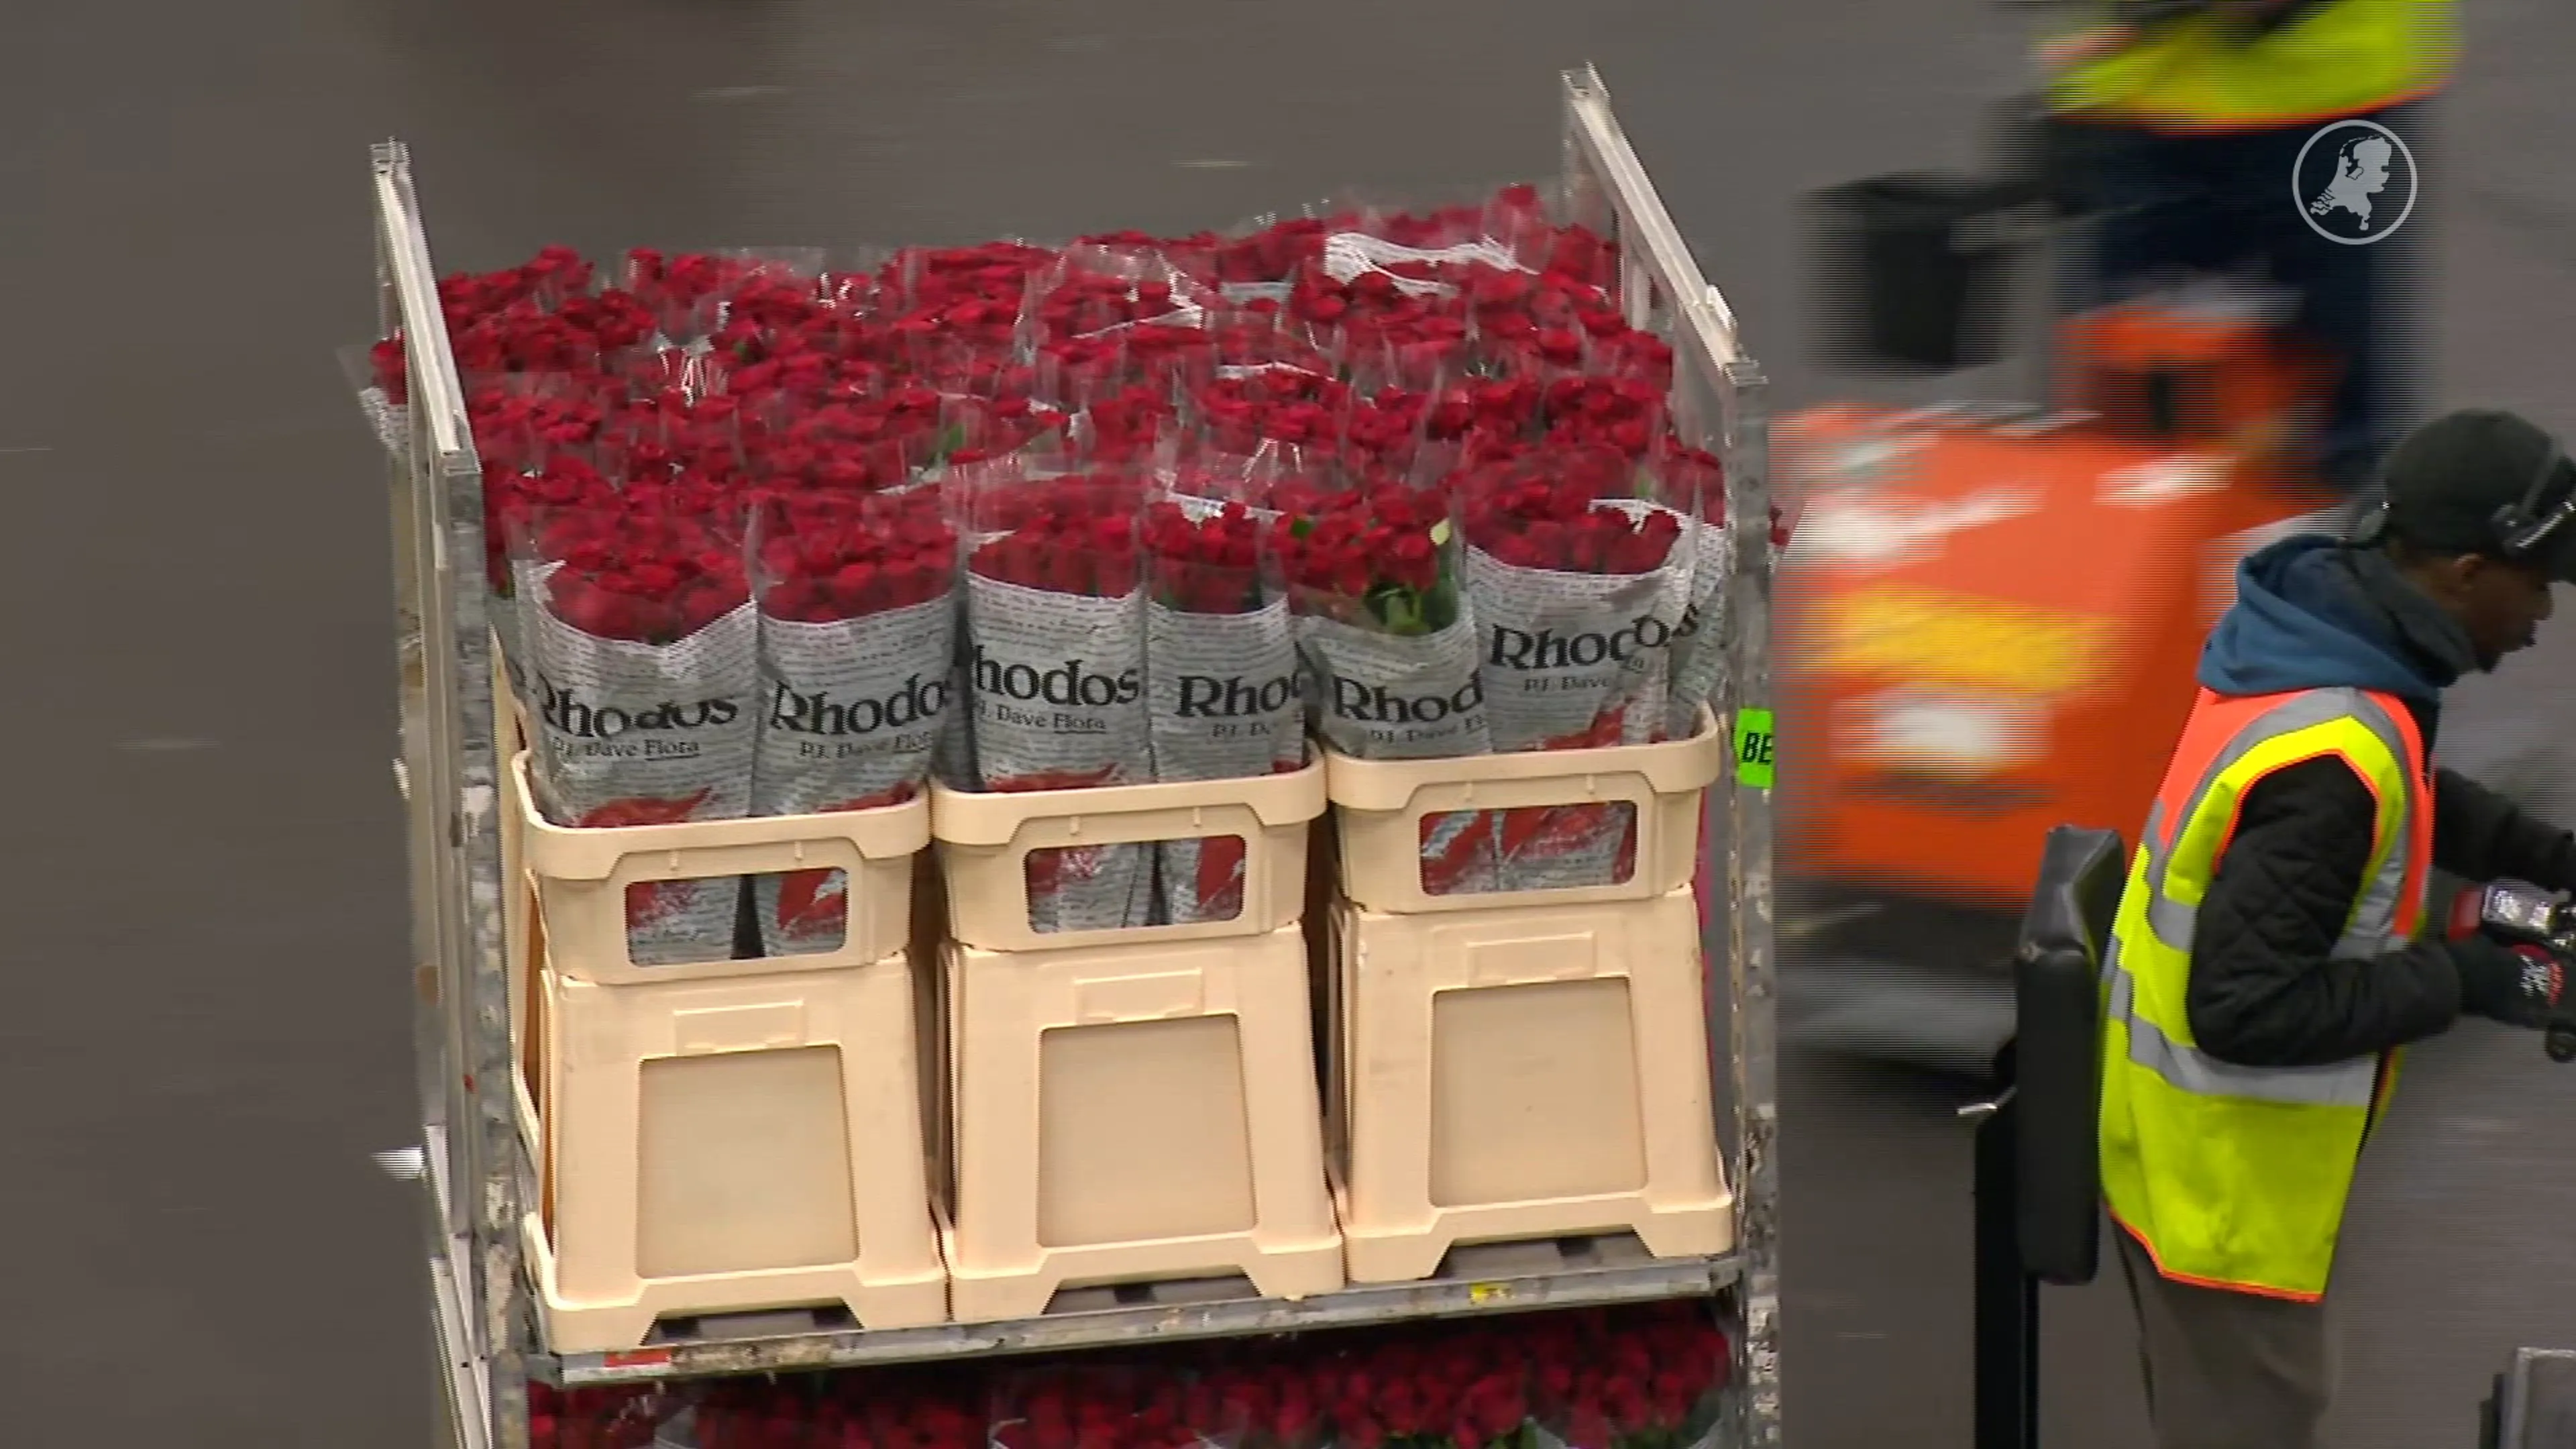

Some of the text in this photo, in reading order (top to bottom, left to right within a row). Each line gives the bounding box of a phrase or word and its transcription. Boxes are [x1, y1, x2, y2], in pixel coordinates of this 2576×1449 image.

[975, 644, 1139, 706] hodos
[1173, 670, 1301, 716] Rho
[1333, 667, 1483, 722] Rhod
[996, 704, 1046, 728] Dave
[1053, 712, 1107, 733] Flora
[643, 739, 702, 759] Flora
